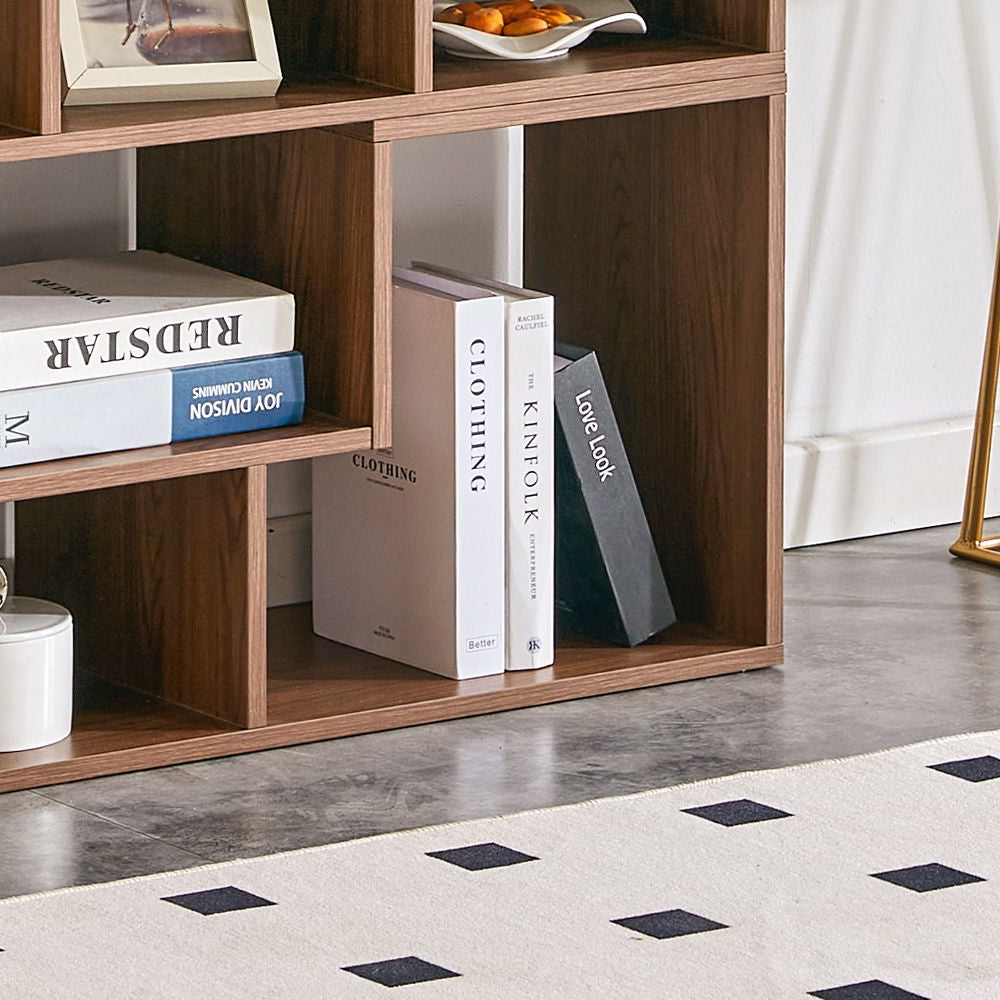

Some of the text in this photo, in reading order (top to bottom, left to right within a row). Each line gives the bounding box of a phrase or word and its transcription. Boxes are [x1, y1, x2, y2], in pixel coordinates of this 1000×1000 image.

[43, 313, 242, 371] REDSTAR
[190, 391, 284, 420] JOY DIVISON
[192, 377, 273, 399] KEVIN CUMMINS
[470, 338, 487, 493] CLOTHING
[575, 389, 617, 483] Love Look
[352, 453, 417, 483] CLOTHING
[523, 401, 539, 525] KINFOLK
[468, 639, 496, 650] Better
